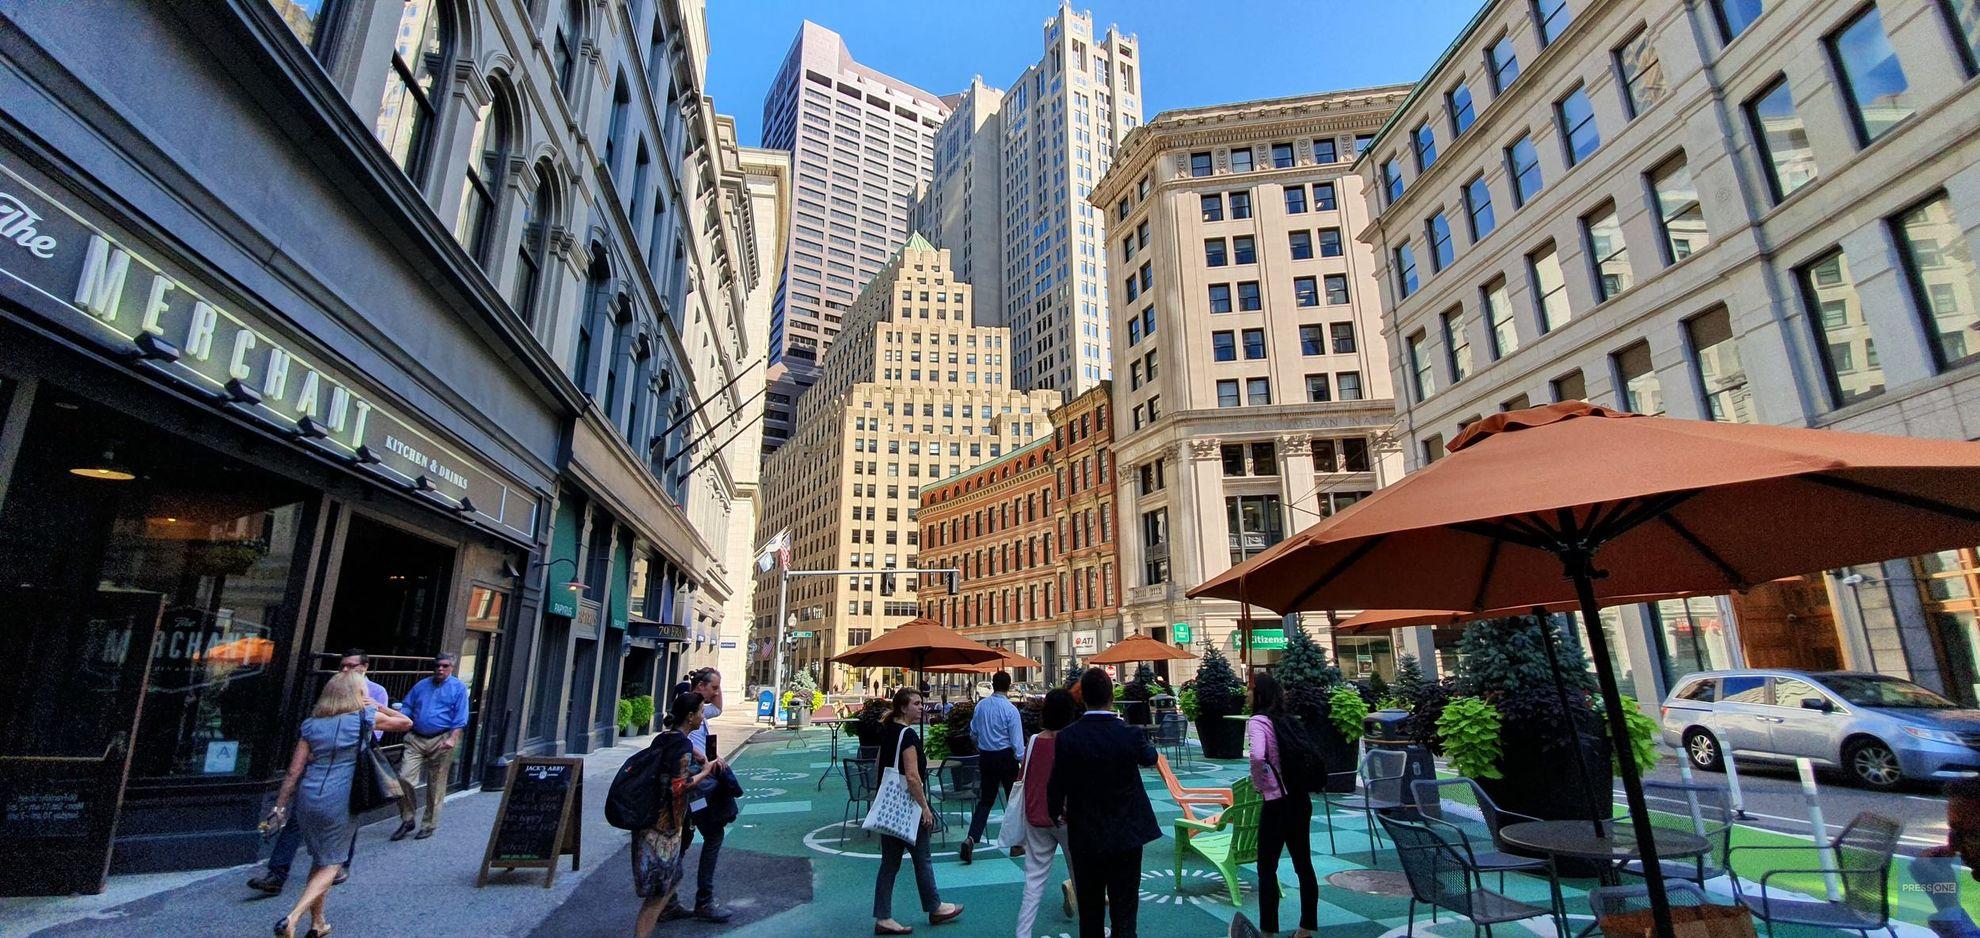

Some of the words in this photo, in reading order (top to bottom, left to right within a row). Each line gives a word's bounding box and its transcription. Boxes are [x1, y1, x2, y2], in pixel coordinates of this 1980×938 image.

[74, 234, 371, 447] MERCHANT
[385, 435, 427, 468] KITCHEN
[429, 459, 438, 474] &
[438, 465, 468, 489] DRINKS
[102, 629, 262, 666] MRCHANT
[658, 625, 669, 637] 70
[1081, 637, 1093, 645] ATI
